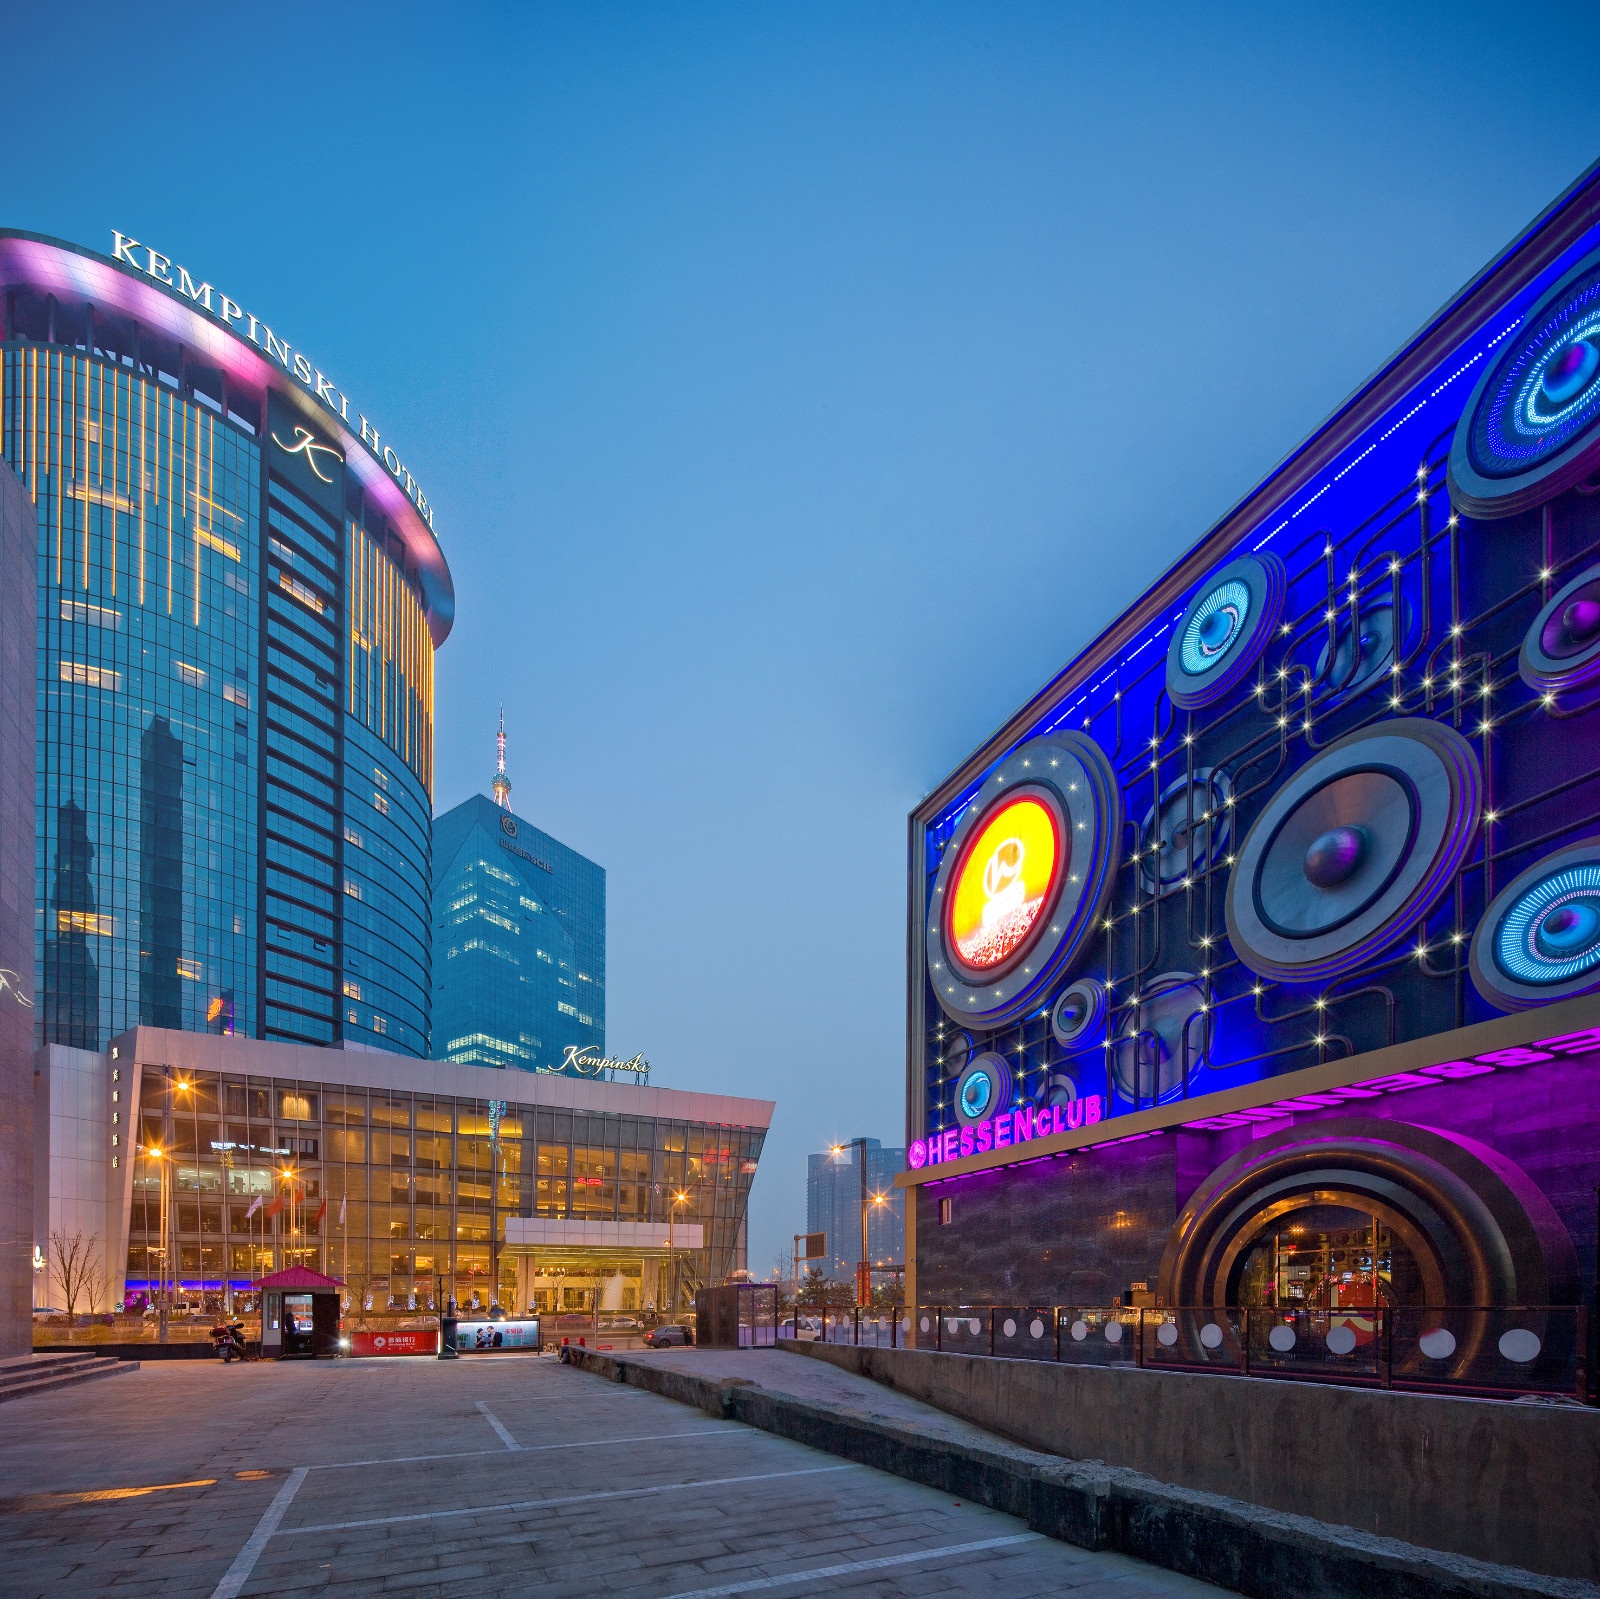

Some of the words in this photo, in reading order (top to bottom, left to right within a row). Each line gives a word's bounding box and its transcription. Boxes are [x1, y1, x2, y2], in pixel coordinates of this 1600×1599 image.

[111, 229, 349, 424] KEMPINSKI
[359, 412, 438, 539] HOTEL
[548, 1045, 651, 1076] Kempinski
[928, 1106, 1034, 1166] HESSEN
[1036, 1094, 1102, 1137] CLUB
